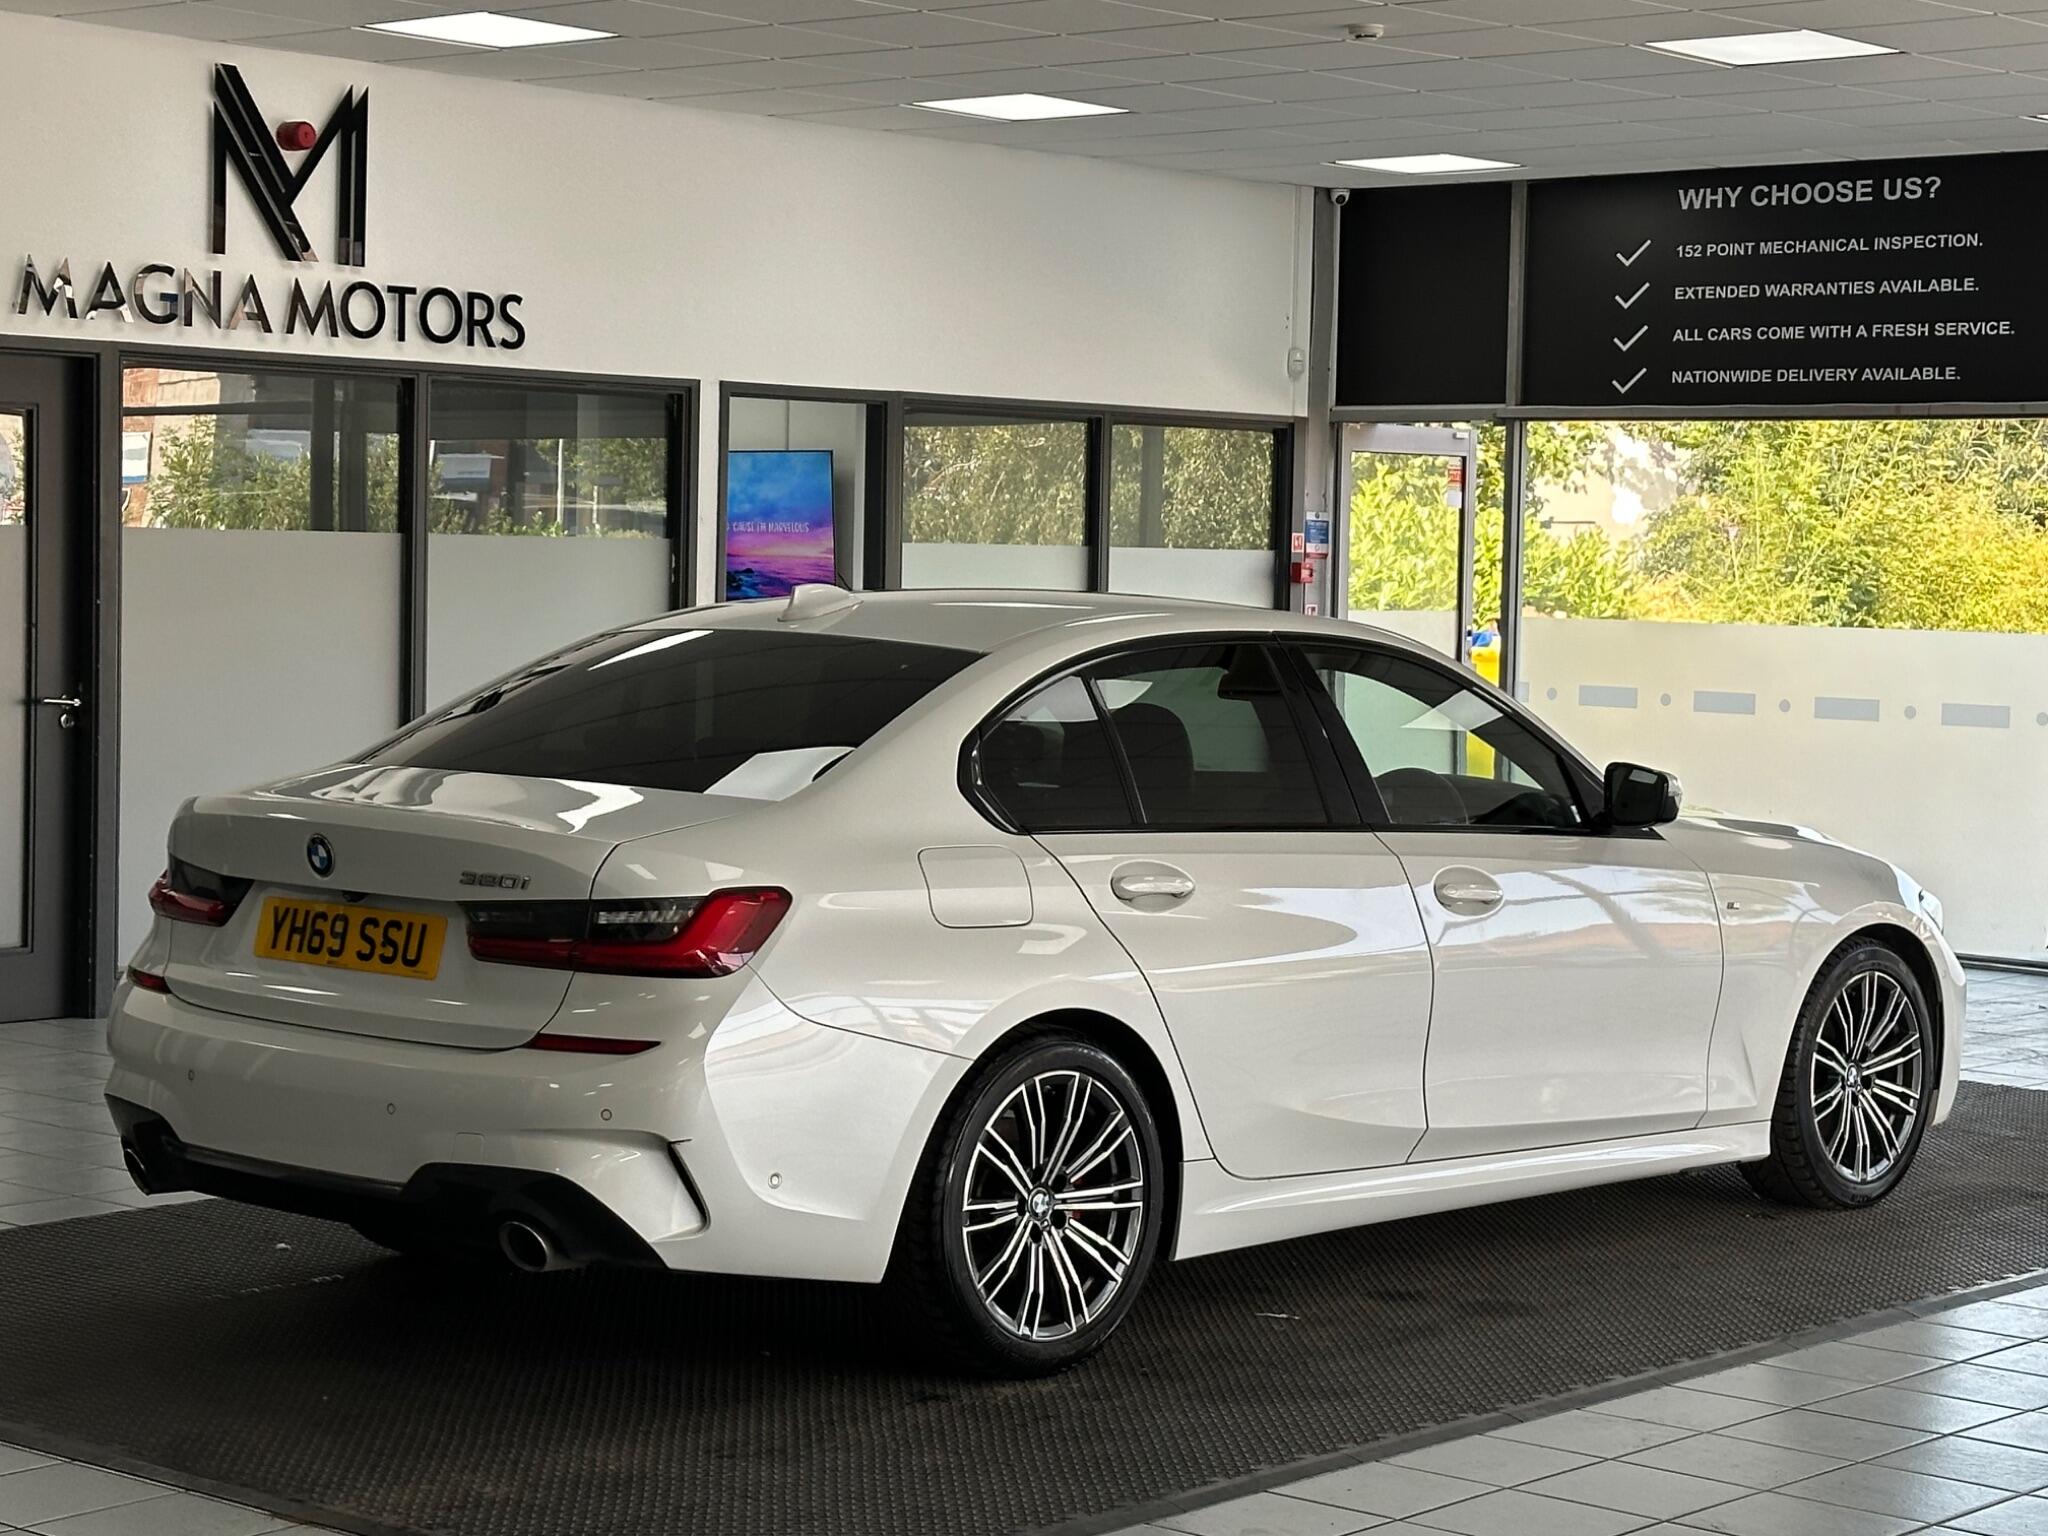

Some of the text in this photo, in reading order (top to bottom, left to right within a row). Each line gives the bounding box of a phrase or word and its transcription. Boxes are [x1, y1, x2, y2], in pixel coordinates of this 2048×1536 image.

[1678, 176, 1942, 210] WHY CHOOSE US?
[1675, 233, 1984, 258] 152 POINT MECHANICAL INSPECTION.
[16, 253, 526, 350] MAGNA MOTORS
[1674, 278, 1979, 300] EXTENDED WARRANTIES AVAILABLE.
[1672, 321, 2015, 342] ALL CARS COME WITH A FRESH SERVICE.
[1671, 366, 1961, 384] NATIONWIDE DELIVERY AVAILABLE.
[270, 905, 428, 968] YH69 SSU
